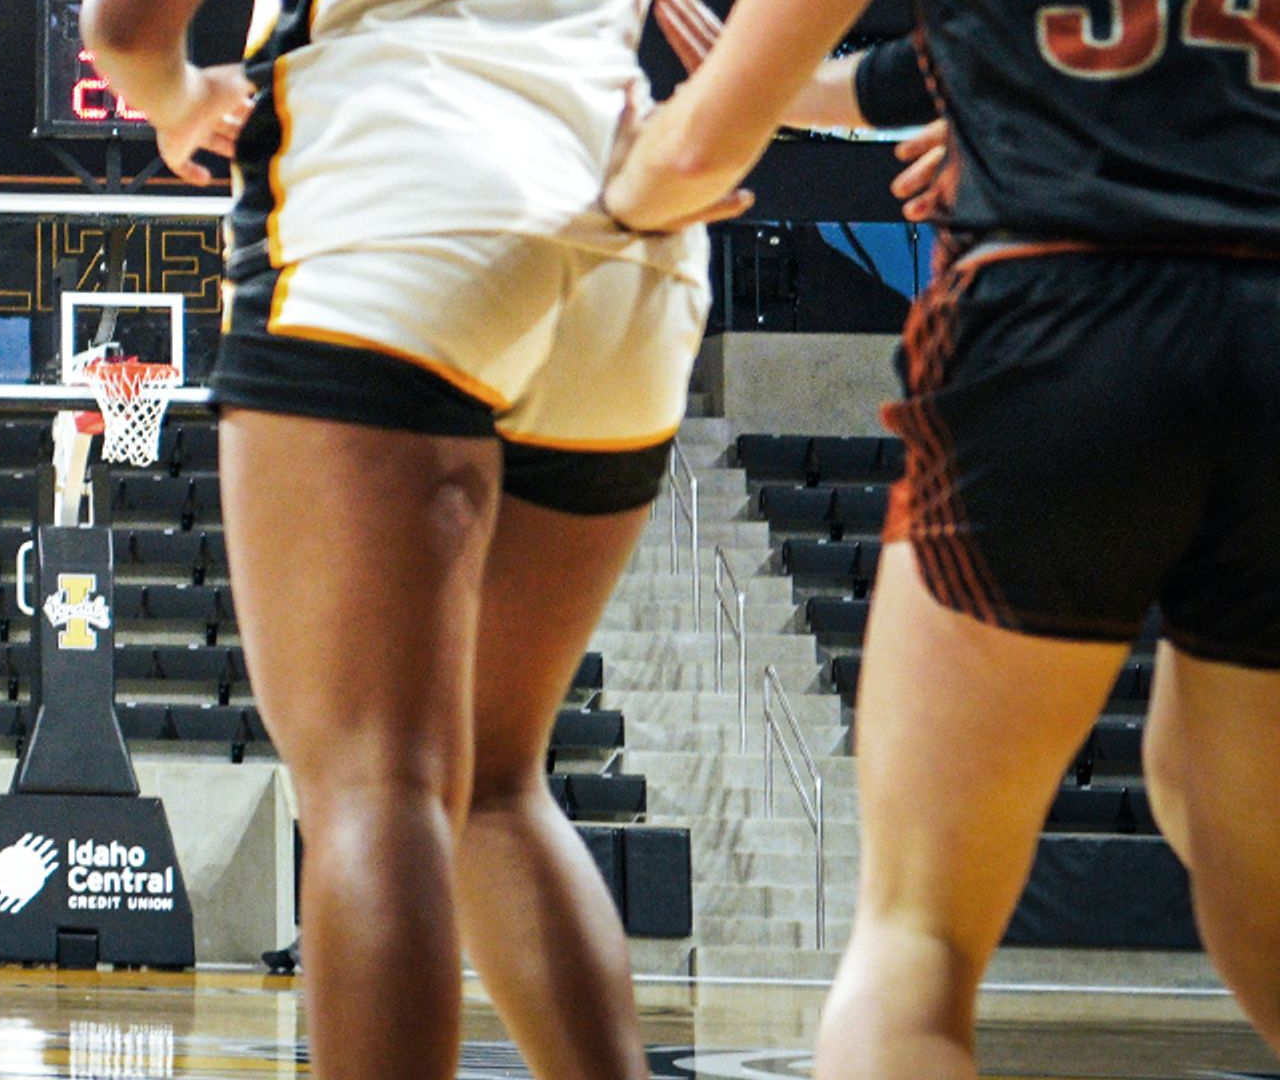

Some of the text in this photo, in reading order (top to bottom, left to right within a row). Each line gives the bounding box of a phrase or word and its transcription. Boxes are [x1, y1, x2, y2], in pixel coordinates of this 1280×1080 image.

[67, 838, 146, 867] Idaho
[67, 866, 174, 893] Central
[67, 895, 174, 911] CREDIT UNION
